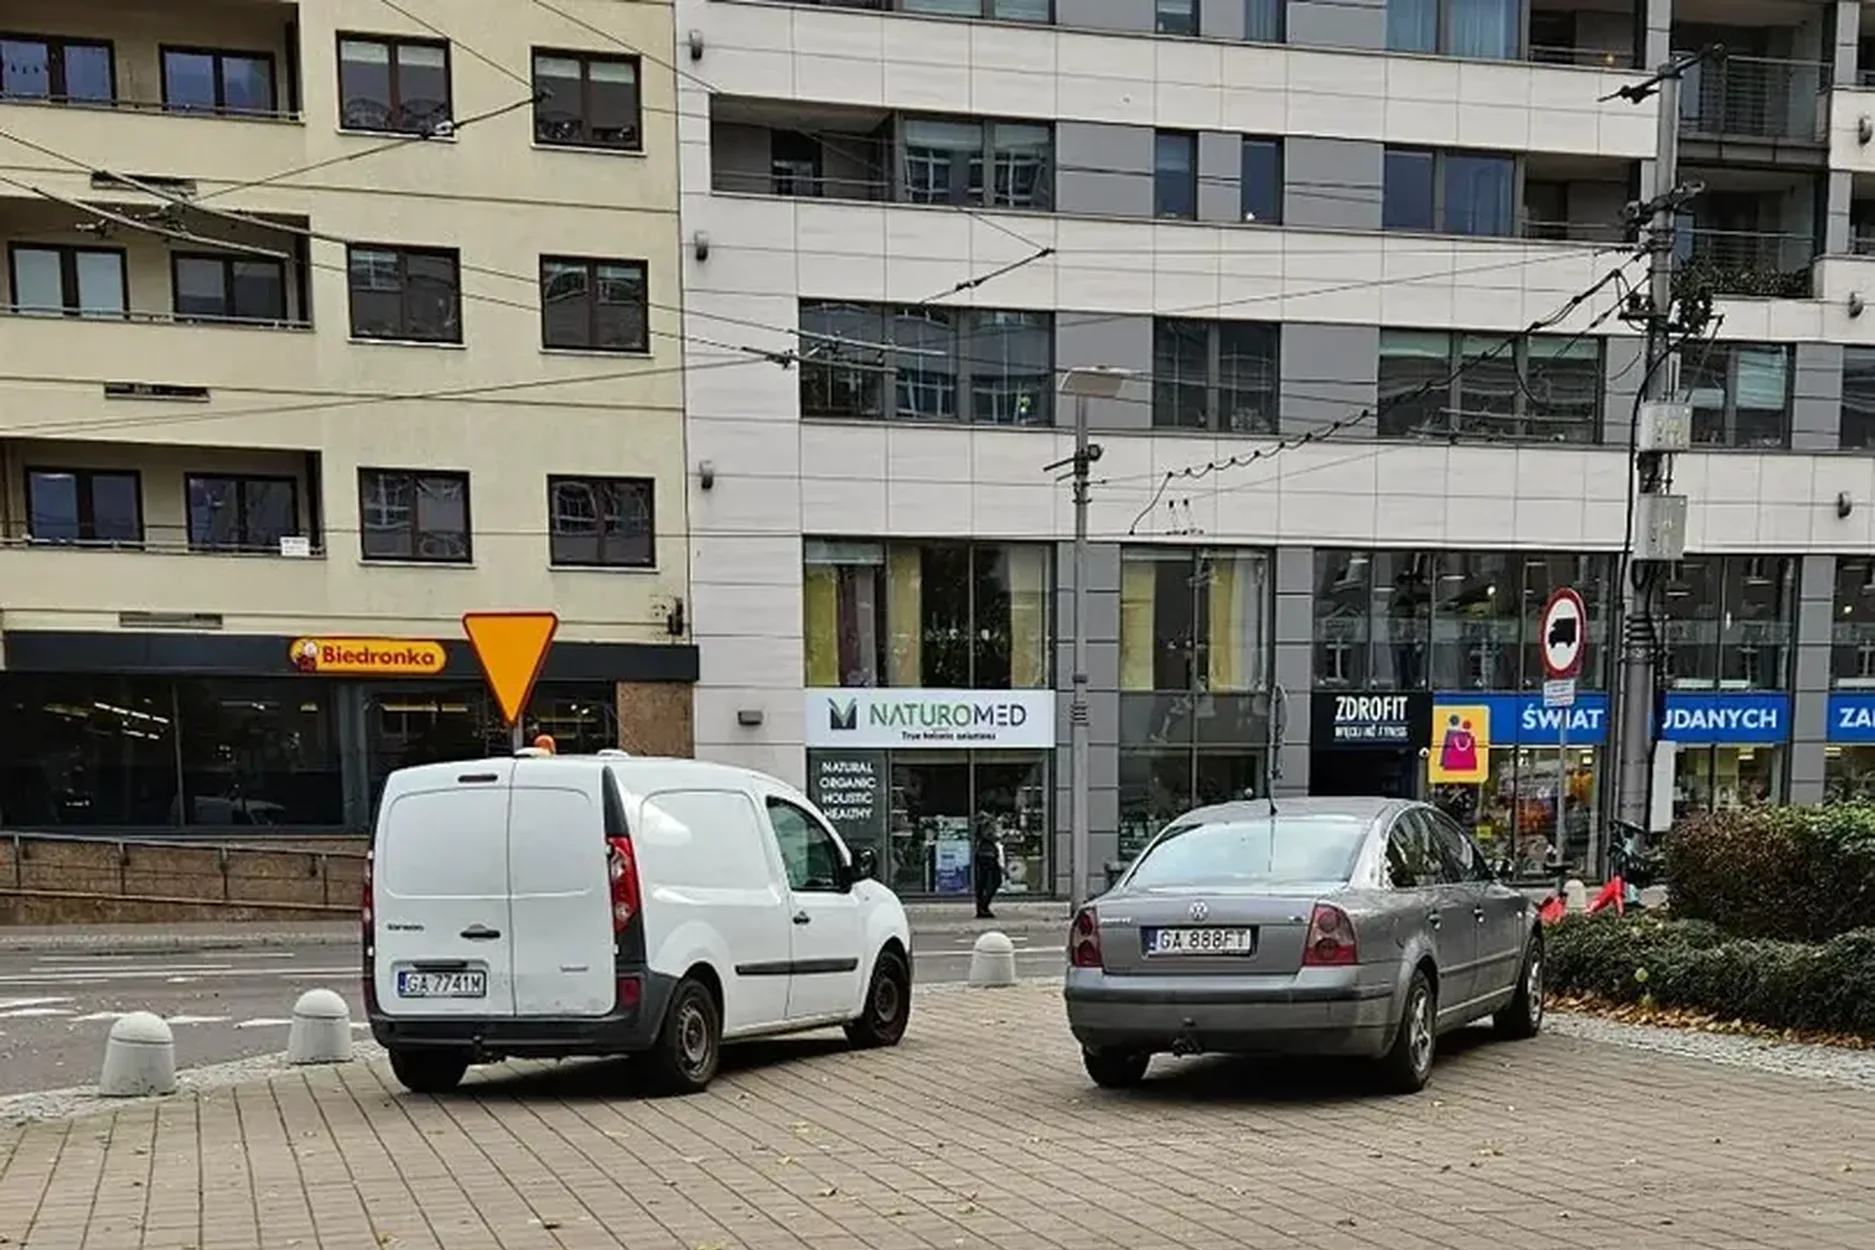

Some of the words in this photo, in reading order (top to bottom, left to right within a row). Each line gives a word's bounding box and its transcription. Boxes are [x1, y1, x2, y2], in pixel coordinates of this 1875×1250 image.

[322, 645, 435, 666] Biedronka
[869, 703, 1027, 726] NATUROMED
[1334, 696, 1408, 721] ZDROFIT
[1522, 705, 1605, 730] ŚWIAT
[1838, 707, 1875, 728] ZA
[821, 761, 873, 773] NATURAL
[819, 776, 877, 789] ORGANIC
[821, 791, 873, 804] HOLISTIC
[823, 807, 873, 820] HEALTHY
[1161, 930, 1181, 950] GA
[1190, 930, 1247, 949] 888FT
[408, 975, 429, 993] GA
